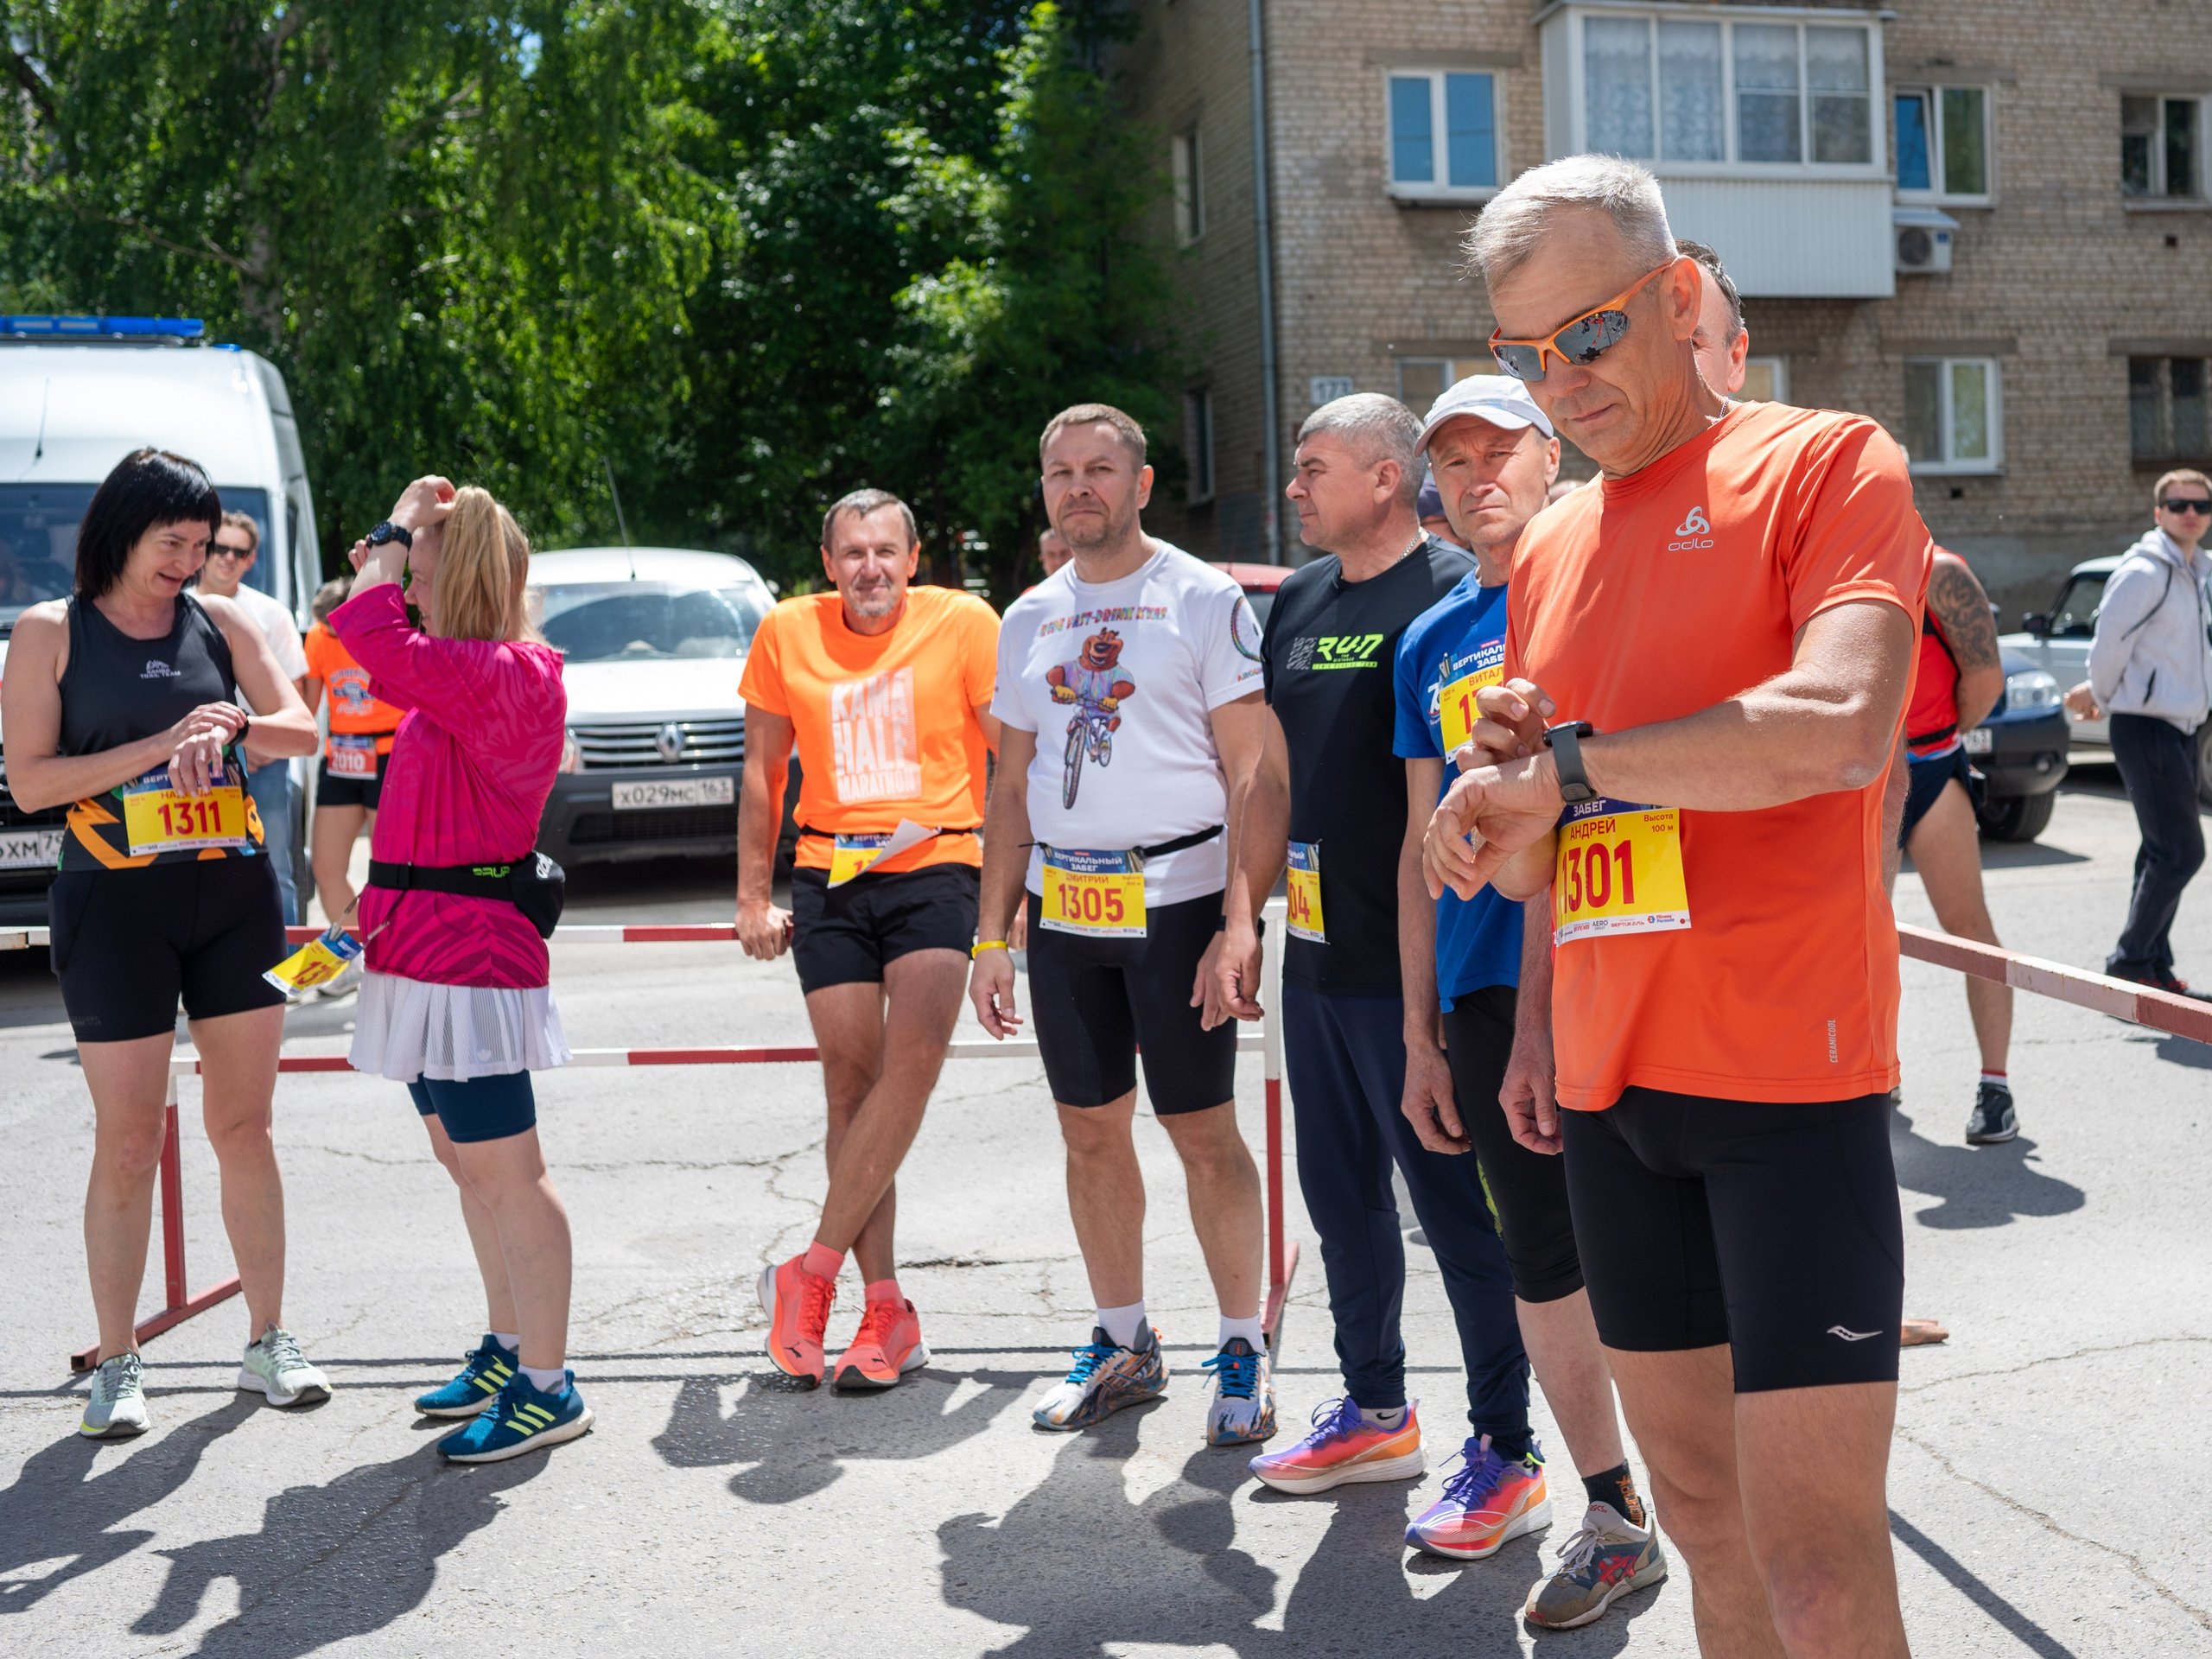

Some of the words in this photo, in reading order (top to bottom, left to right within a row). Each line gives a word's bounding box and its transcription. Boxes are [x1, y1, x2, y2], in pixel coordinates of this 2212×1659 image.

[1668, 538, 1714, 551] odlo
[1317, 633, 1383, 661] RUN
[1477, 653, 1503, 668] ЗАБЕ
[1469, 666, 1503, 686] ВИТАЛ
[831, 672, 908, 722] KAMA
[832, 717, 910, 776] HALF
[332, 751, 366, 772] 2010
[836, 766, 917, 802] MARATHON
[157, 801, 222, 836] 1311
[1573, 799, 1606, 817] ЗАБЕГ
[1570, 816, 1617, 841] АНДРЕЙ
[1643, 813, 1674, 822] Высота
[1651, 824, 1666, 833] 100
[1054, 852, 1123, 865] ВЕРТИКАЛЬНЫЙ
[1071, 863, 1099, 872] ЗАБЕГ
[1065, 873, 1109, 884] ДМИТРИЙ
[1562, 839, 1635, 915] 1301
[1058, 883, 1124, 922] 1305
[1827, 1019, 1839, 1064] CERAMICOOL
